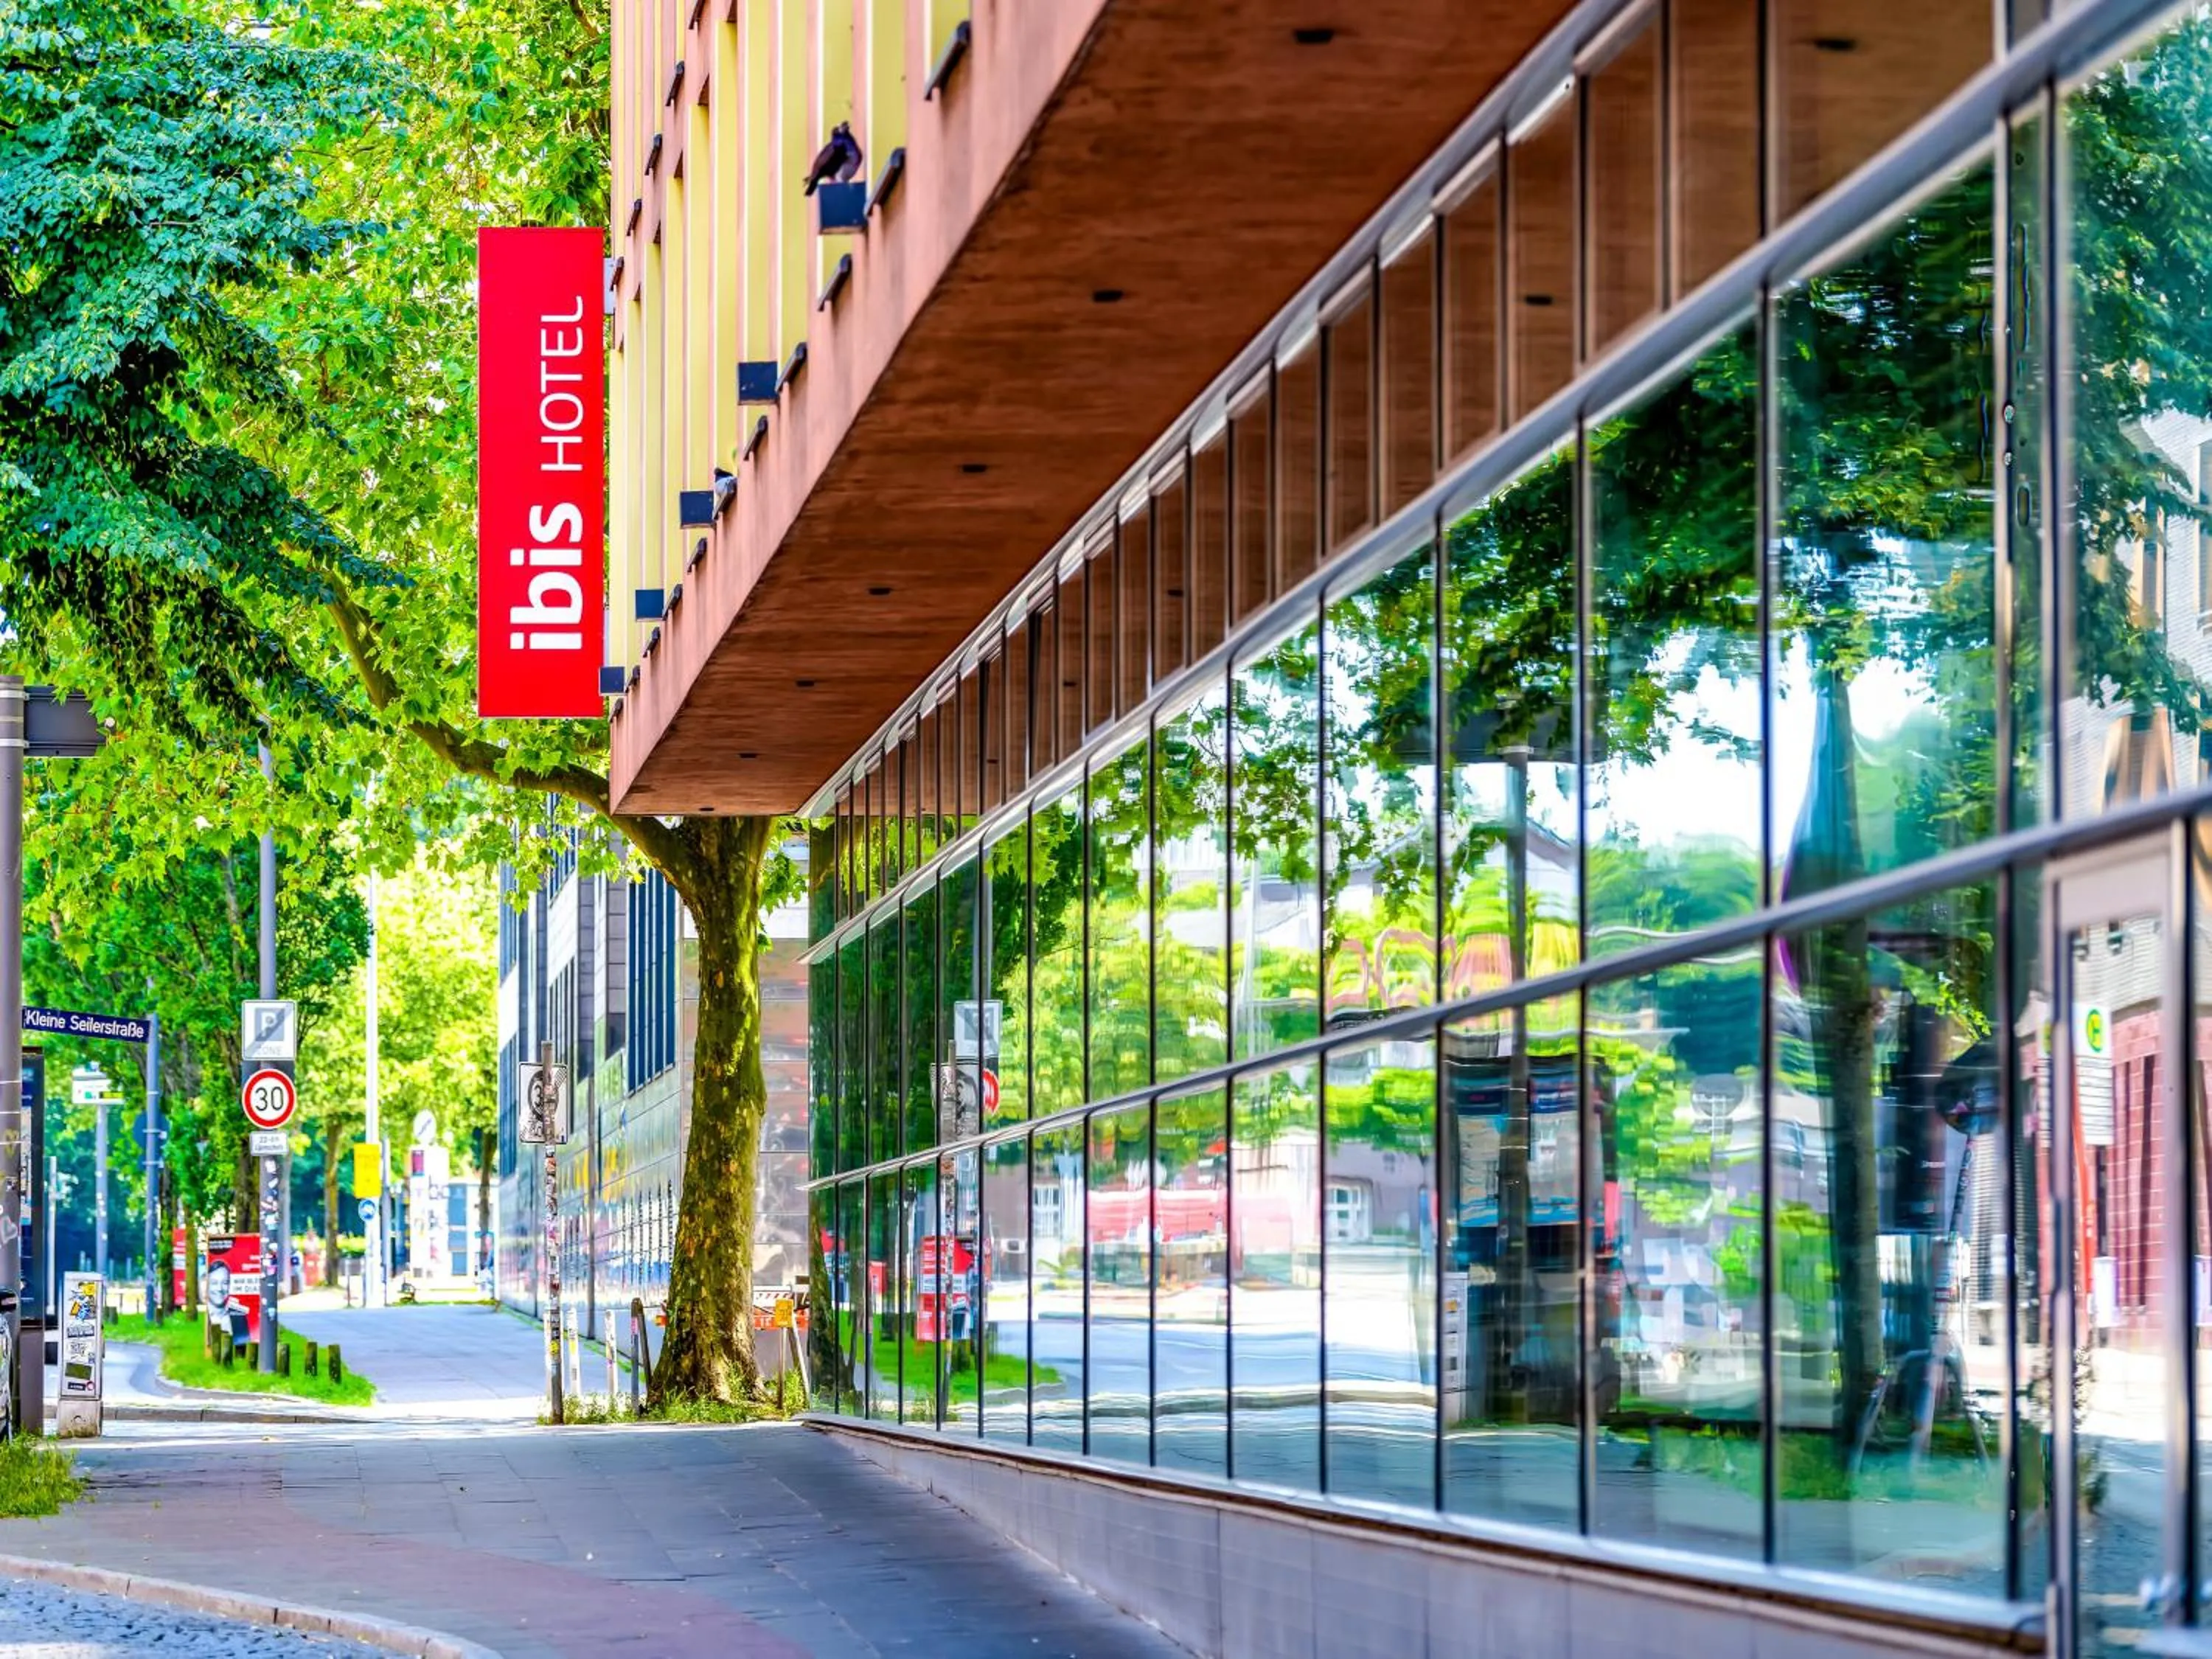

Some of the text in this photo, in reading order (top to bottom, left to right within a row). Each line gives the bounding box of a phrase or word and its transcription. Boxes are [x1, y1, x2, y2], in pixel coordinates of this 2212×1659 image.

[509, 295, 584, 650] ibis HOTEL
[26, 1009, 144, 1038] Kleine Seilerstraße
[255, 1086, 284, 1111] 30
